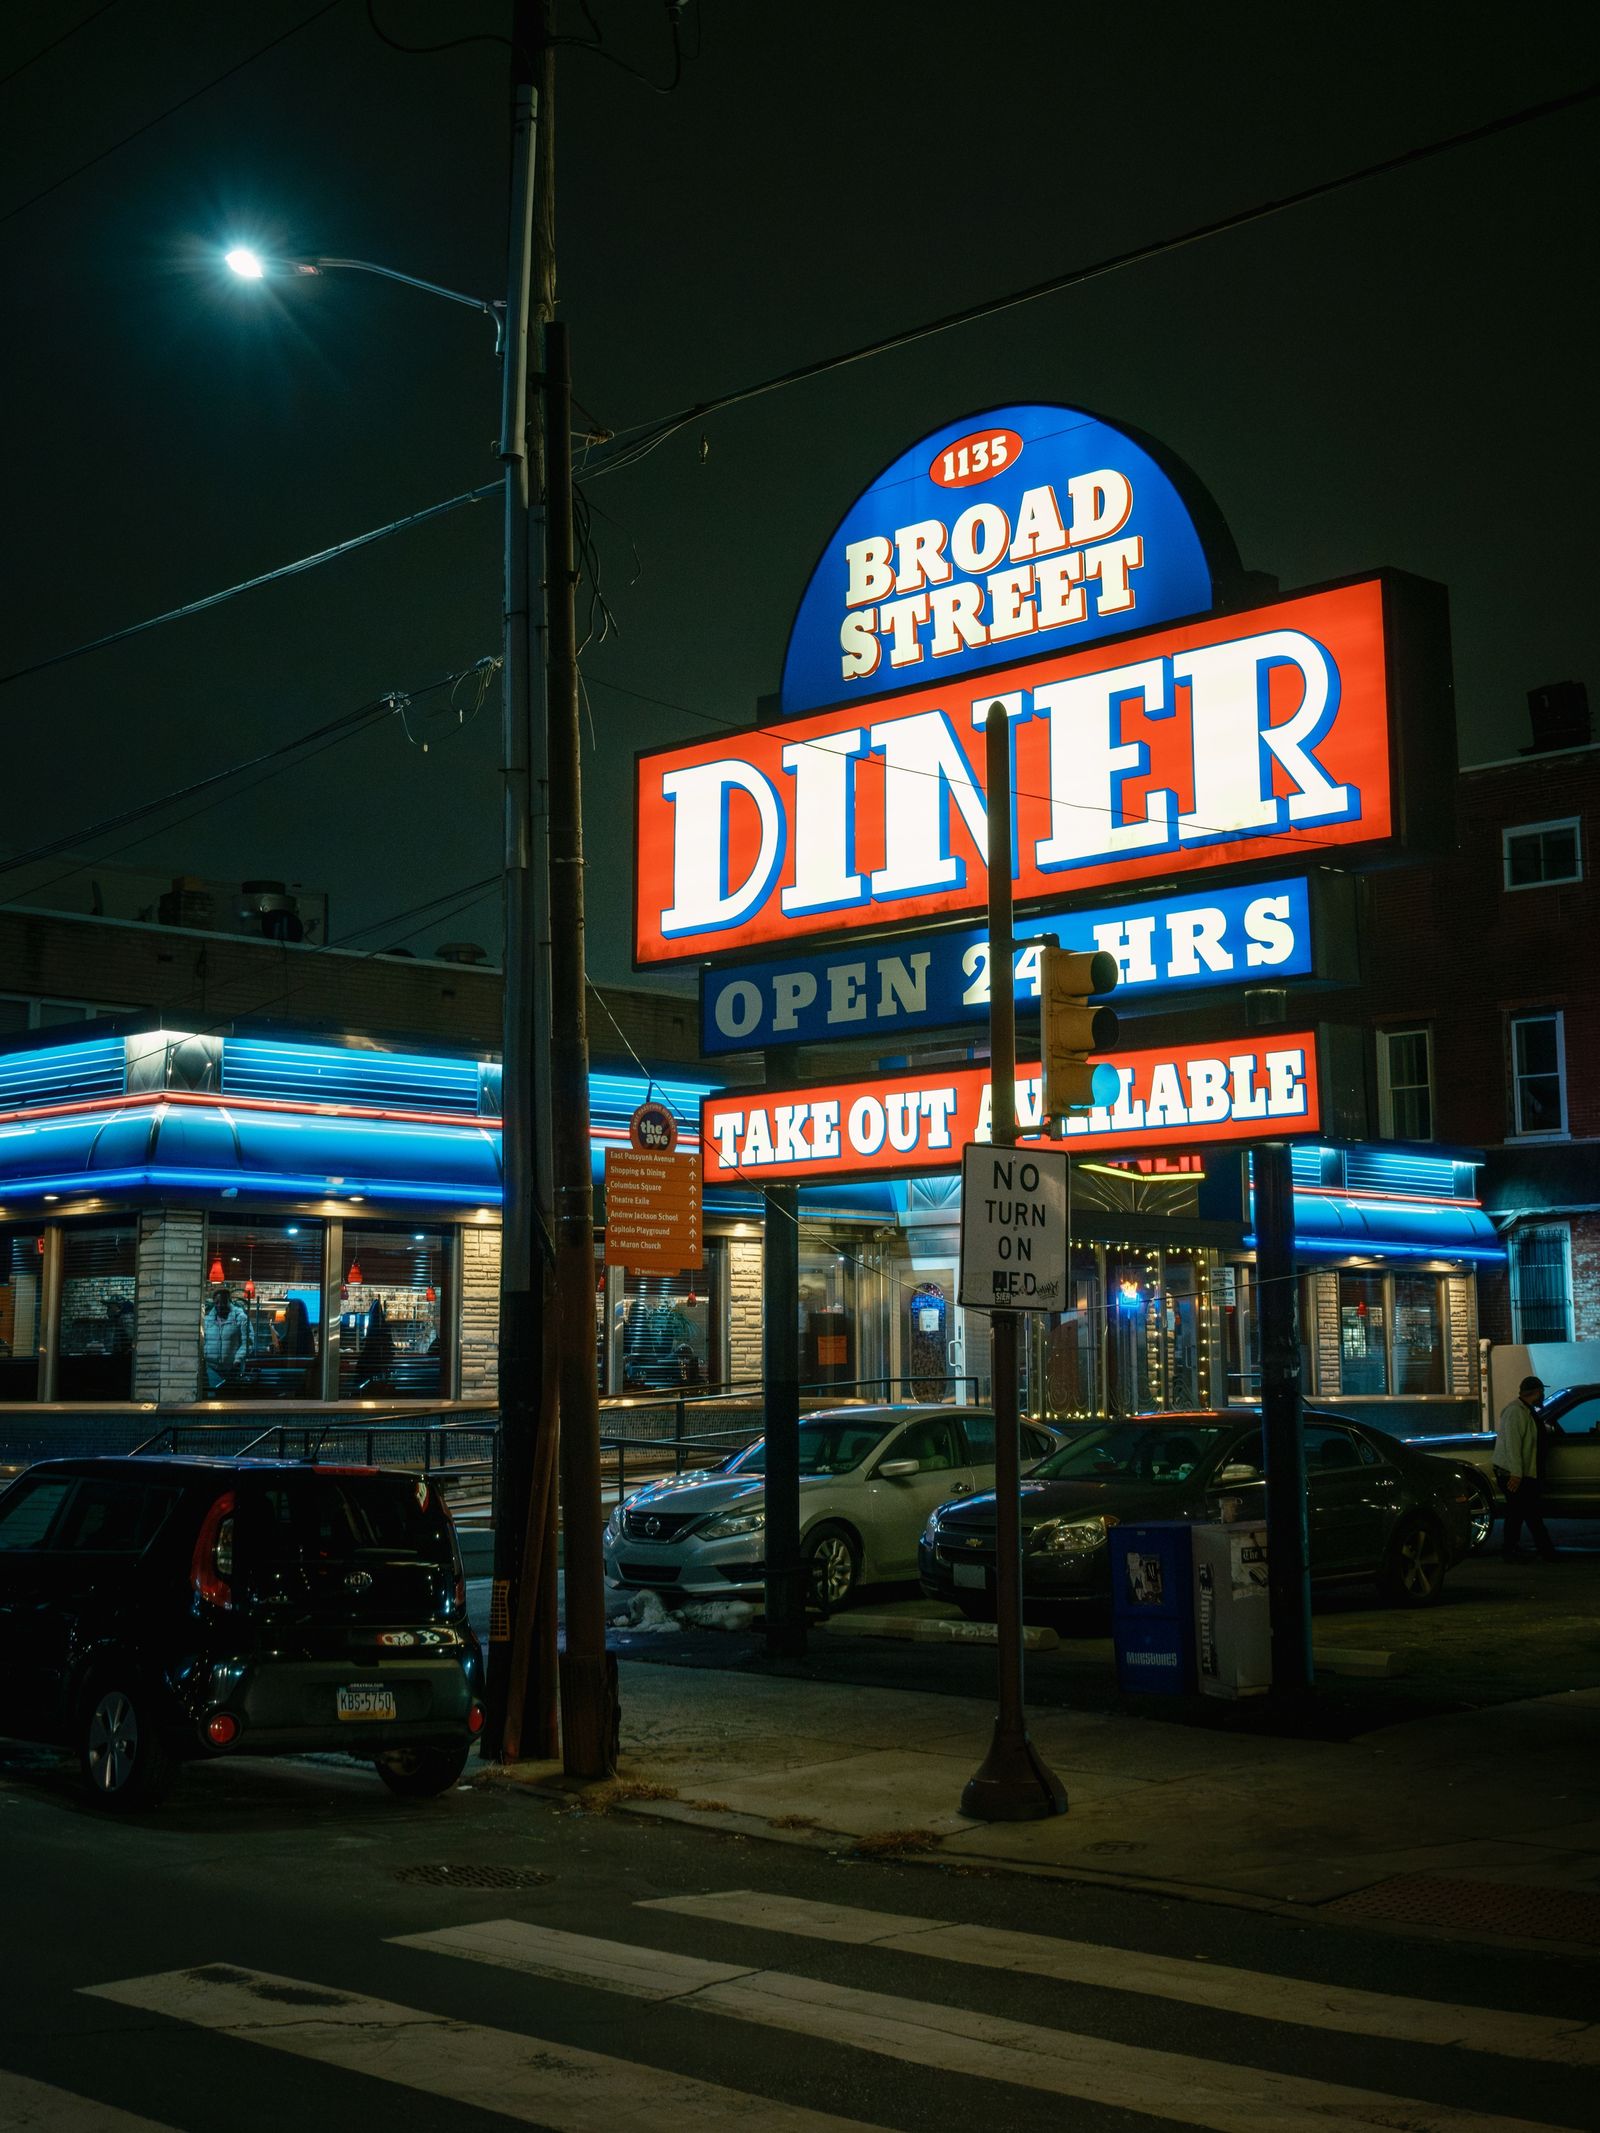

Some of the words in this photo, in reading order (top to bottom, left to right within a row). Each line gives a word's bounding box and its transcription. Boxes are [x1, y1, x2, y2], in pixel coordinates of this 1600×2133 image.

[943, 436, 1008, 482] 1135
[845, 469, 1134, 609] BROAD
[840, 535, 1144, 681] STREET
[660, 629, 1362, 940] DINER
[715, 951, 931, 1038] OPEN
[962, 934, 1050, 1006] 24
[1092, 895, 1296, 986] HRS
[713, 1099, 842, 1170] TAKE
[848, 1087, 957, 1156] OUT
[974, 1049, 1308, 1143] VLABLE
[640, 1120, 663, 1135] the
[646, 1133, 669, 1145] ave
[610, 1151, 624, 1160] East
[624, 1152, 653, 1162] Passyunk
[653, 1155, 676, 1163] Avenue
[610, 1166, 640, 1177] Shopping
[640, 1168, 646, 1176] &
[646, 1169, 666, 1179] Dining
[993, 1160, 1040, 1192] NO
[610, 1180, 640, 1190] Columbus
[640, 1182, 662, 1192] Square
[611, 1195, 634, 1204] Theatre
[634, 1197, 650, 1205] Exile
[610, 1210, 634, 1219] Andrew
[634, 1212, 658, 1220] Jackson
[658, 1213, 679, 1222] School
[984, 1200, 1046, 1227] TURN
[636, 1226, 671, 1237] Playground
[610, 1239, 620, 1248] St.
[640, 1241, 662, 1250] Church
[998, 1236, 1032, 1261] ON
[994, 1271, 1037, 1296] ED
